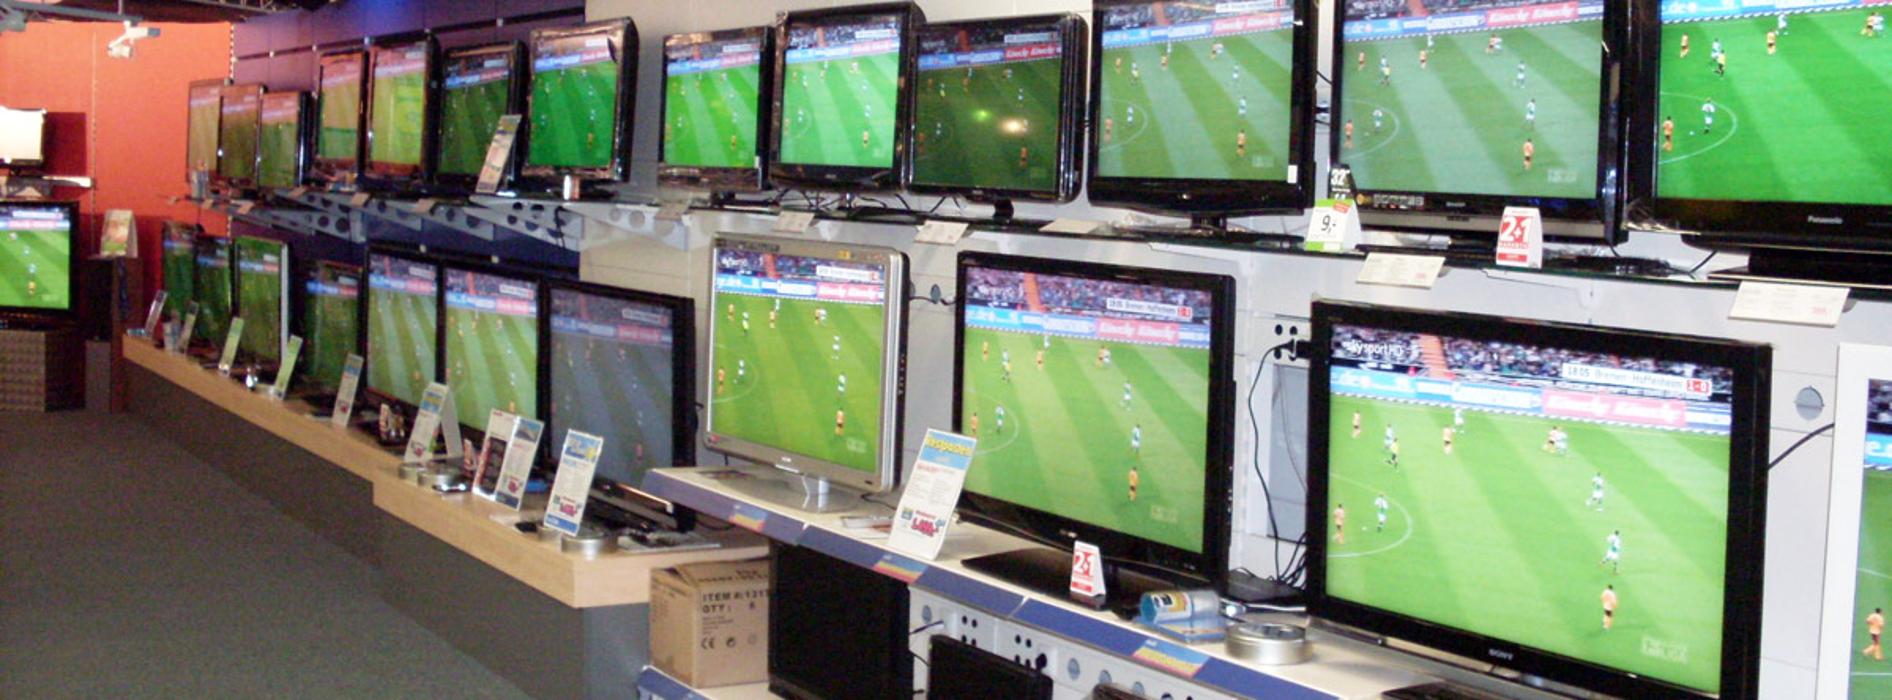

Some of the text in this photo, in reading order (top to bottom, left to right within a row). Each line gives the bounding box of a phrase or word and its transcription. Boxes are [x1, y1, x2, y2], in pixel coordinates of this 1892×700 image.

[1807, 215, 1843, 225] Panasonic
[703, 592, 731, 602] ITEM
[1488, 648, 1514, 661] SONY
